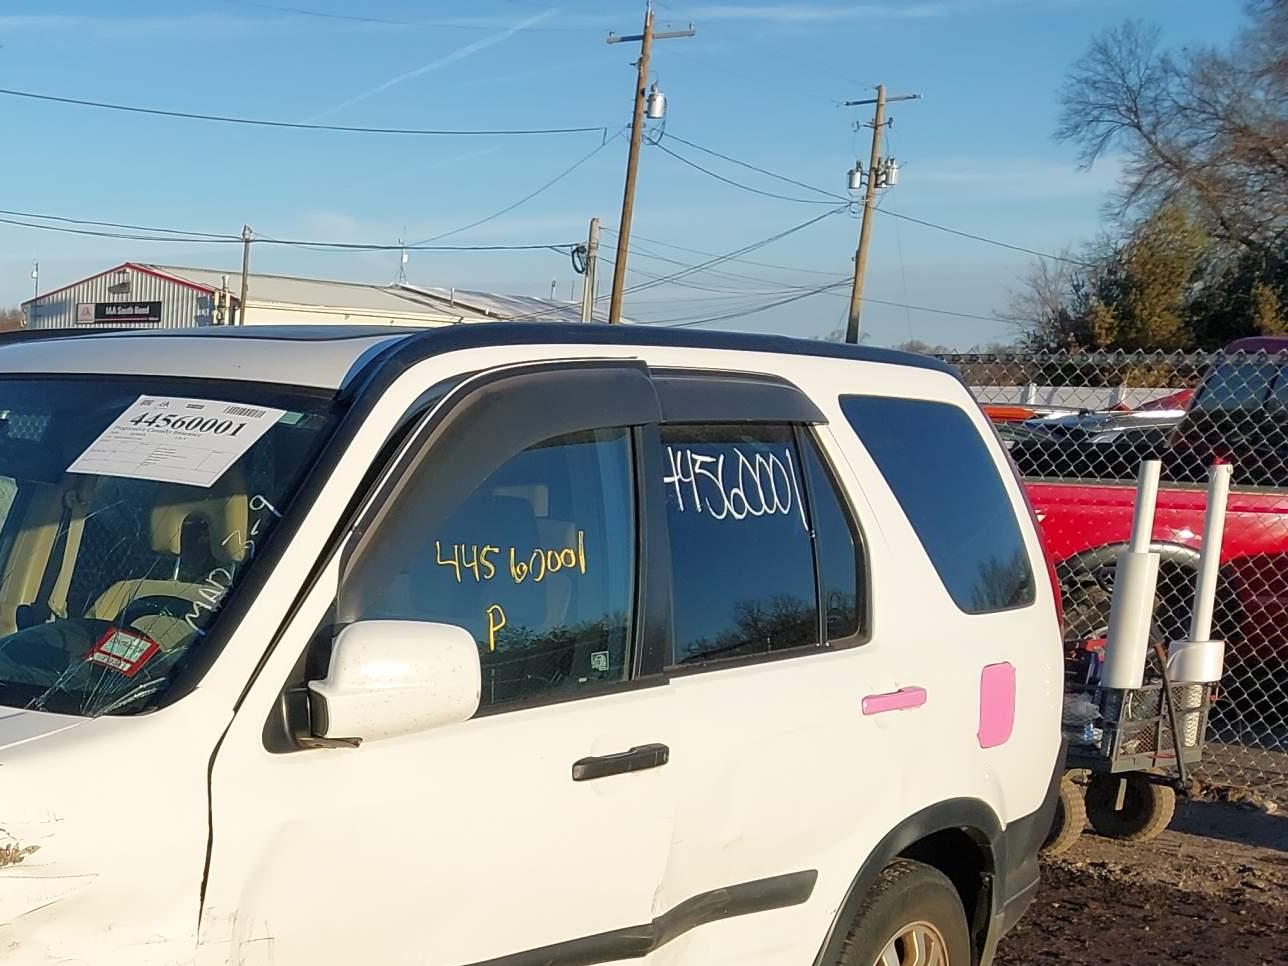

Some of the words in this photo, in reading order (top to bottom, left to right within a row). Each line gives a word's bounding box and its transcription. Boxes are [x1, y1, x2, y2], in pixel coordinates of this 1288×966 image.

[117, 306, 134, 315] South
[134, 305, 150, 315] Bend
[129, 411, 249, 437] 44560001
[486, 604, 507, 652] P
